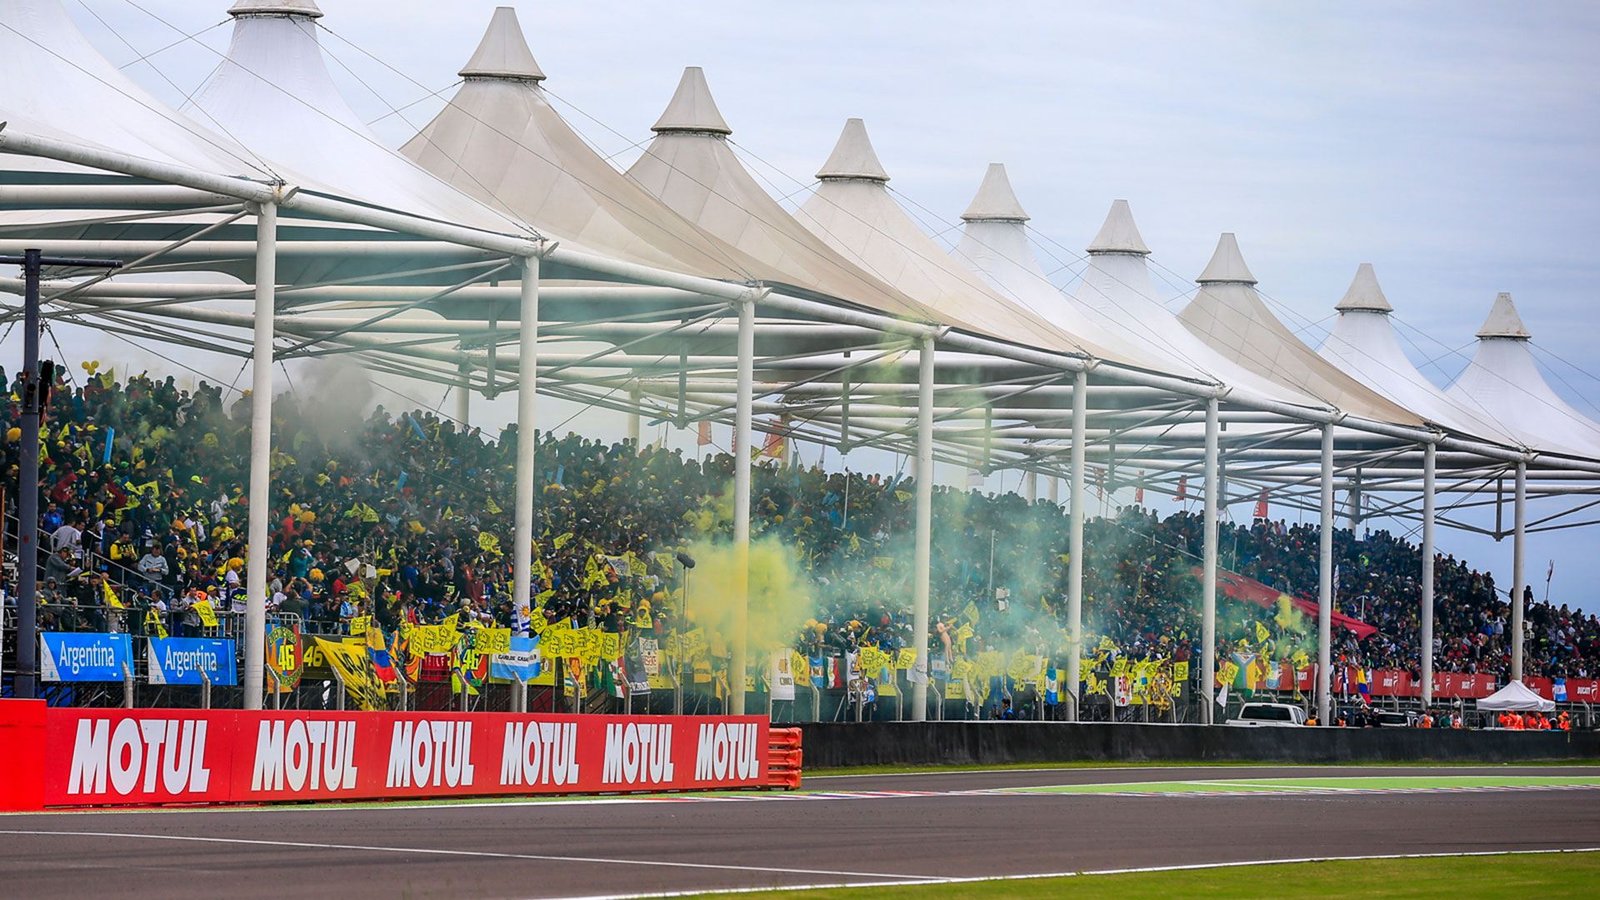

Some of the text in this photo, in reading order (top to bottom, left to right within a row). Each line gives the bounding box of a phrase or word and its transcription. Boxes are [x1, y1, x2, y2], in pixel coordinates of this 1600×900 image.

[59, 640, 115, 674] Argentina
[164, 645, 217, 677] Argentina
[278, 644, 295, 671] 46
[303, 645, 323, 667] 46
[463, 648, 479, 670] 46
[1096, 679, 1108, 695] 46
[1171, 682, 1181, 697] 46
[68, 718, 210, 794] MOTUL
[252, 720, 357, 791] MOTUL
[386, 720, 474, 788] MOTUL
[500, 721, 579, 785] MOTUL
[602, 723, 674, 784] MOTUL
[695, 723, 759, 780] MOTUL
